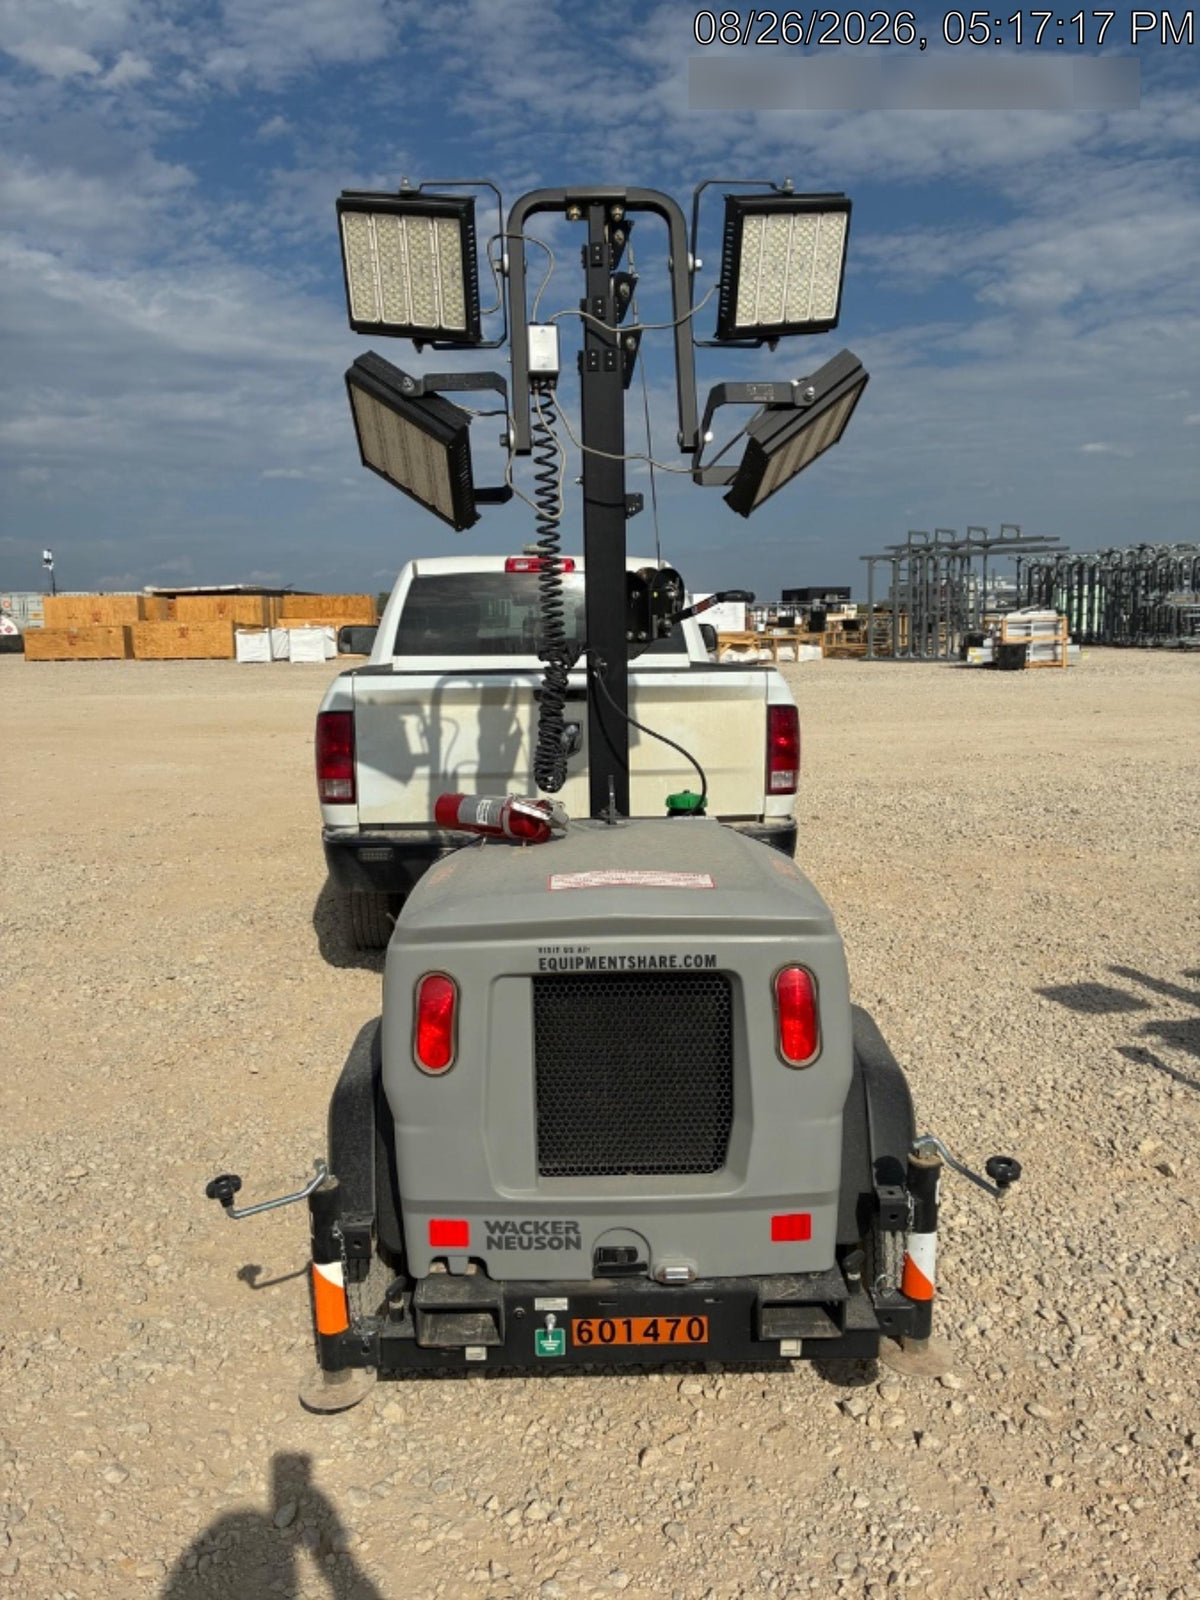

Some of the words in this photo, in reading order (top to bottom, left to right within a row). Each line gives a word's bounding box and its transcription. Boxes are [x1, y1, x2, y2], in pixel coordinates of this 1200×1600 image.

[538, 954, 717, 971] EQUIPMENTSHARE.COM
[483, 1220, 580, 1235] WACKER
[486, 1235, 582, 1251] NEUSON
[575, 1316, 706, 1344] 601470
